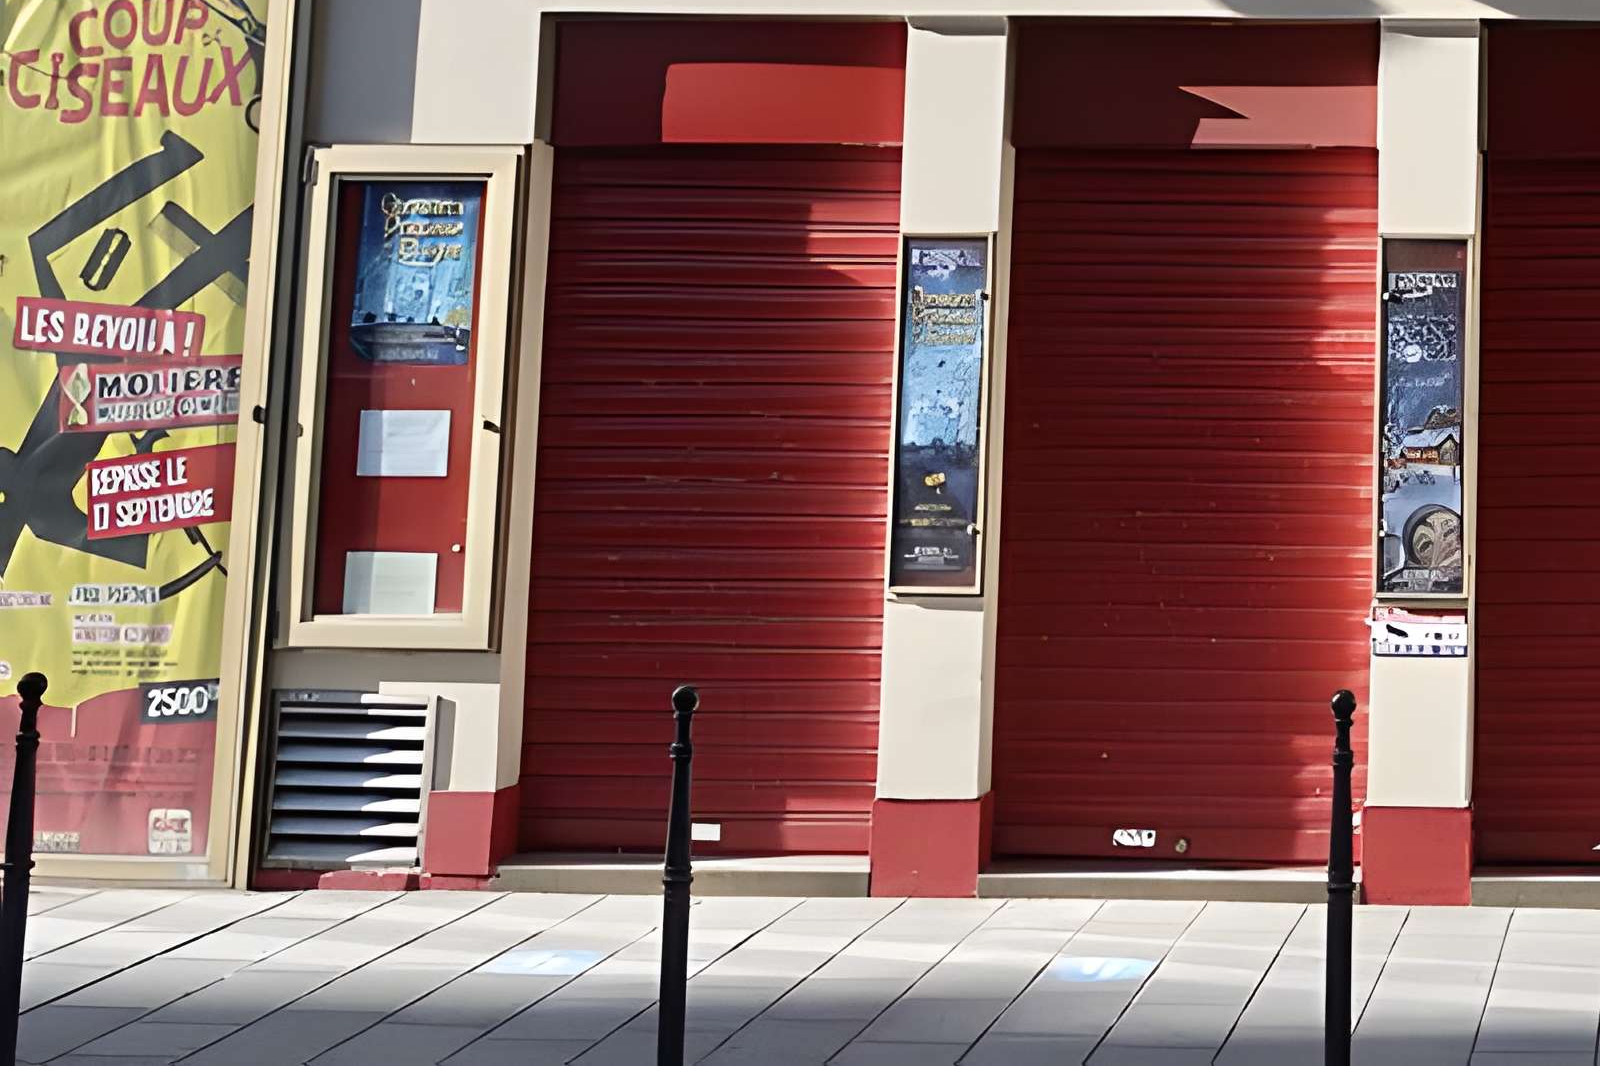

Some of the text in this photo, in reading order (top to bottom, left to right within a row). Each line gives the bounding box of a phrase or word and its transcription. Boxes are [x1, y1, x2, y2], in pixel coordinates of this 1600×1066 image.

[8, 46, 251, 124] CISEAUX
[20, 305, 65, 343] LES
[166, 456, 188, 486] LE
